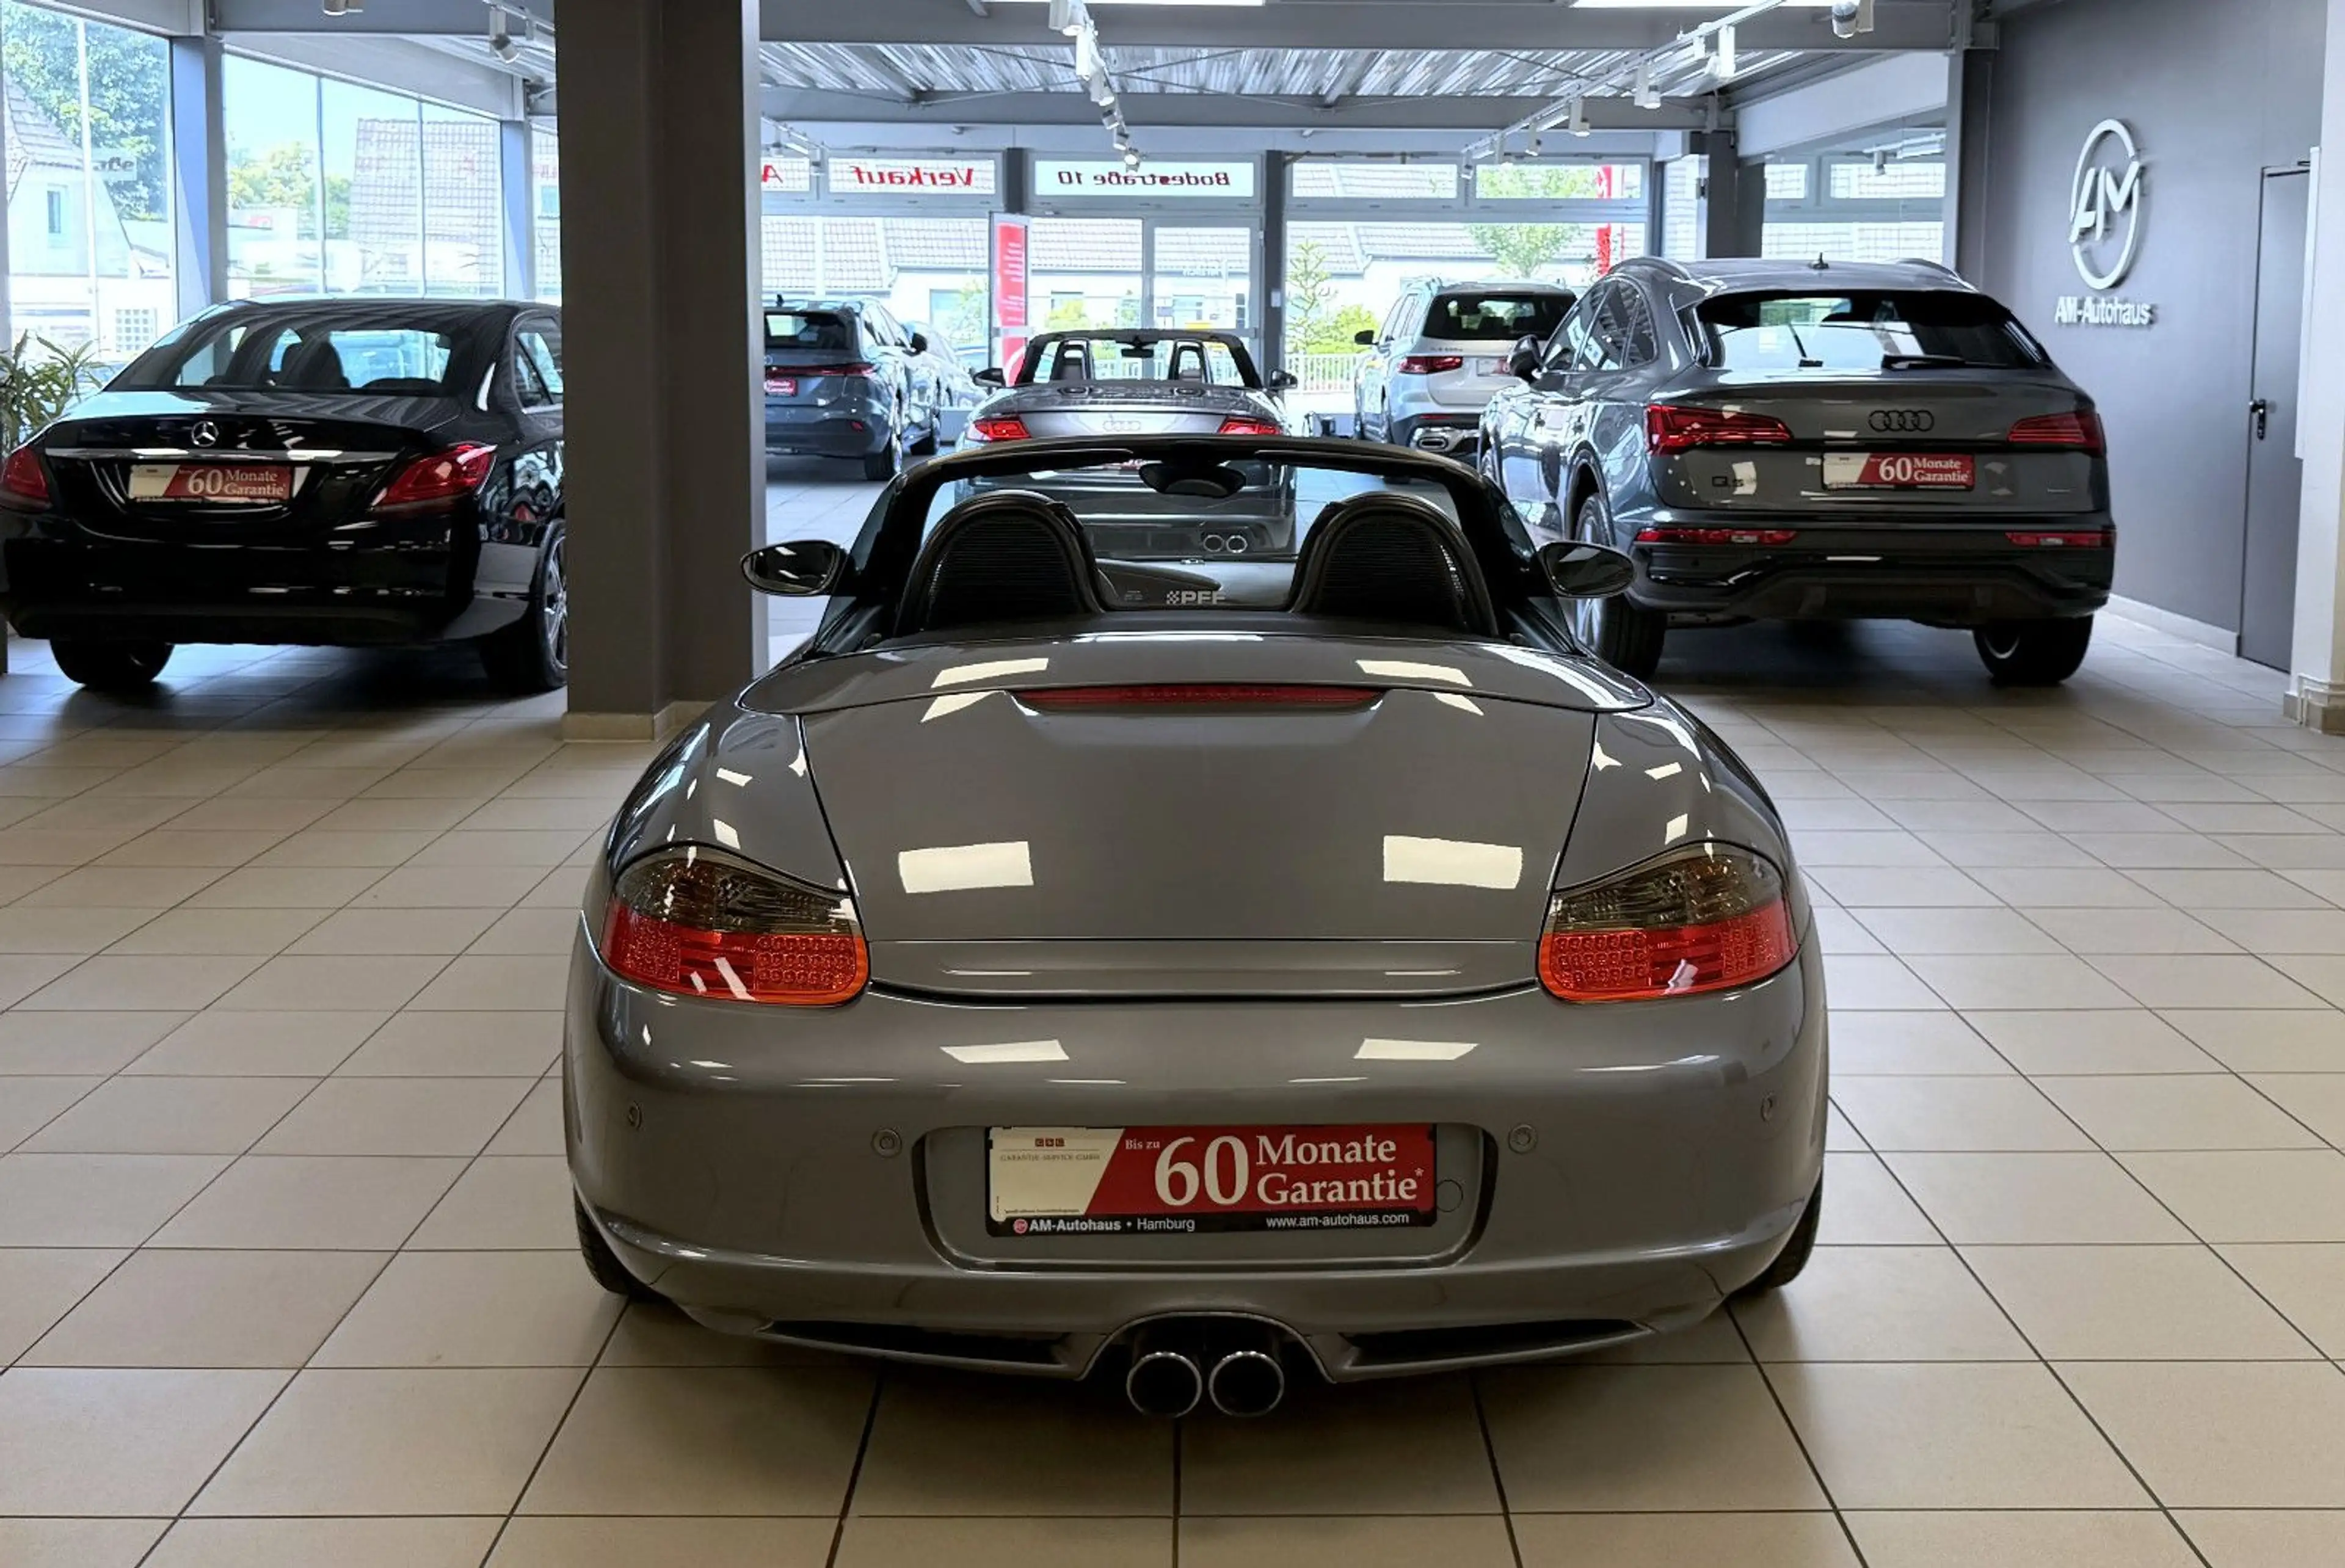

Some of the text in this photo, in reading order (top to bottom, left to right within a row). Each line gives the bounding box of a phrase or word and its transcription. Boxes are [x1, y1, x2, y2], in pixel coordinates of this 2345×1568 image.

[2054, 296, 2151, 325] AM-Autohaus
[188, 468, 278, 495] 60 Monate
[1878, 457, 1961, 482] 60 Monate
[1125, 1134, 1397, 1207] Bis zu 60 Monate
[1029, 1219, 1122, 1232] AM-Autohaus
[1137, 1218, 1196, 1232] Hamburg
[1266, 1213, 1410, 1227] www.am-autohaus.com
